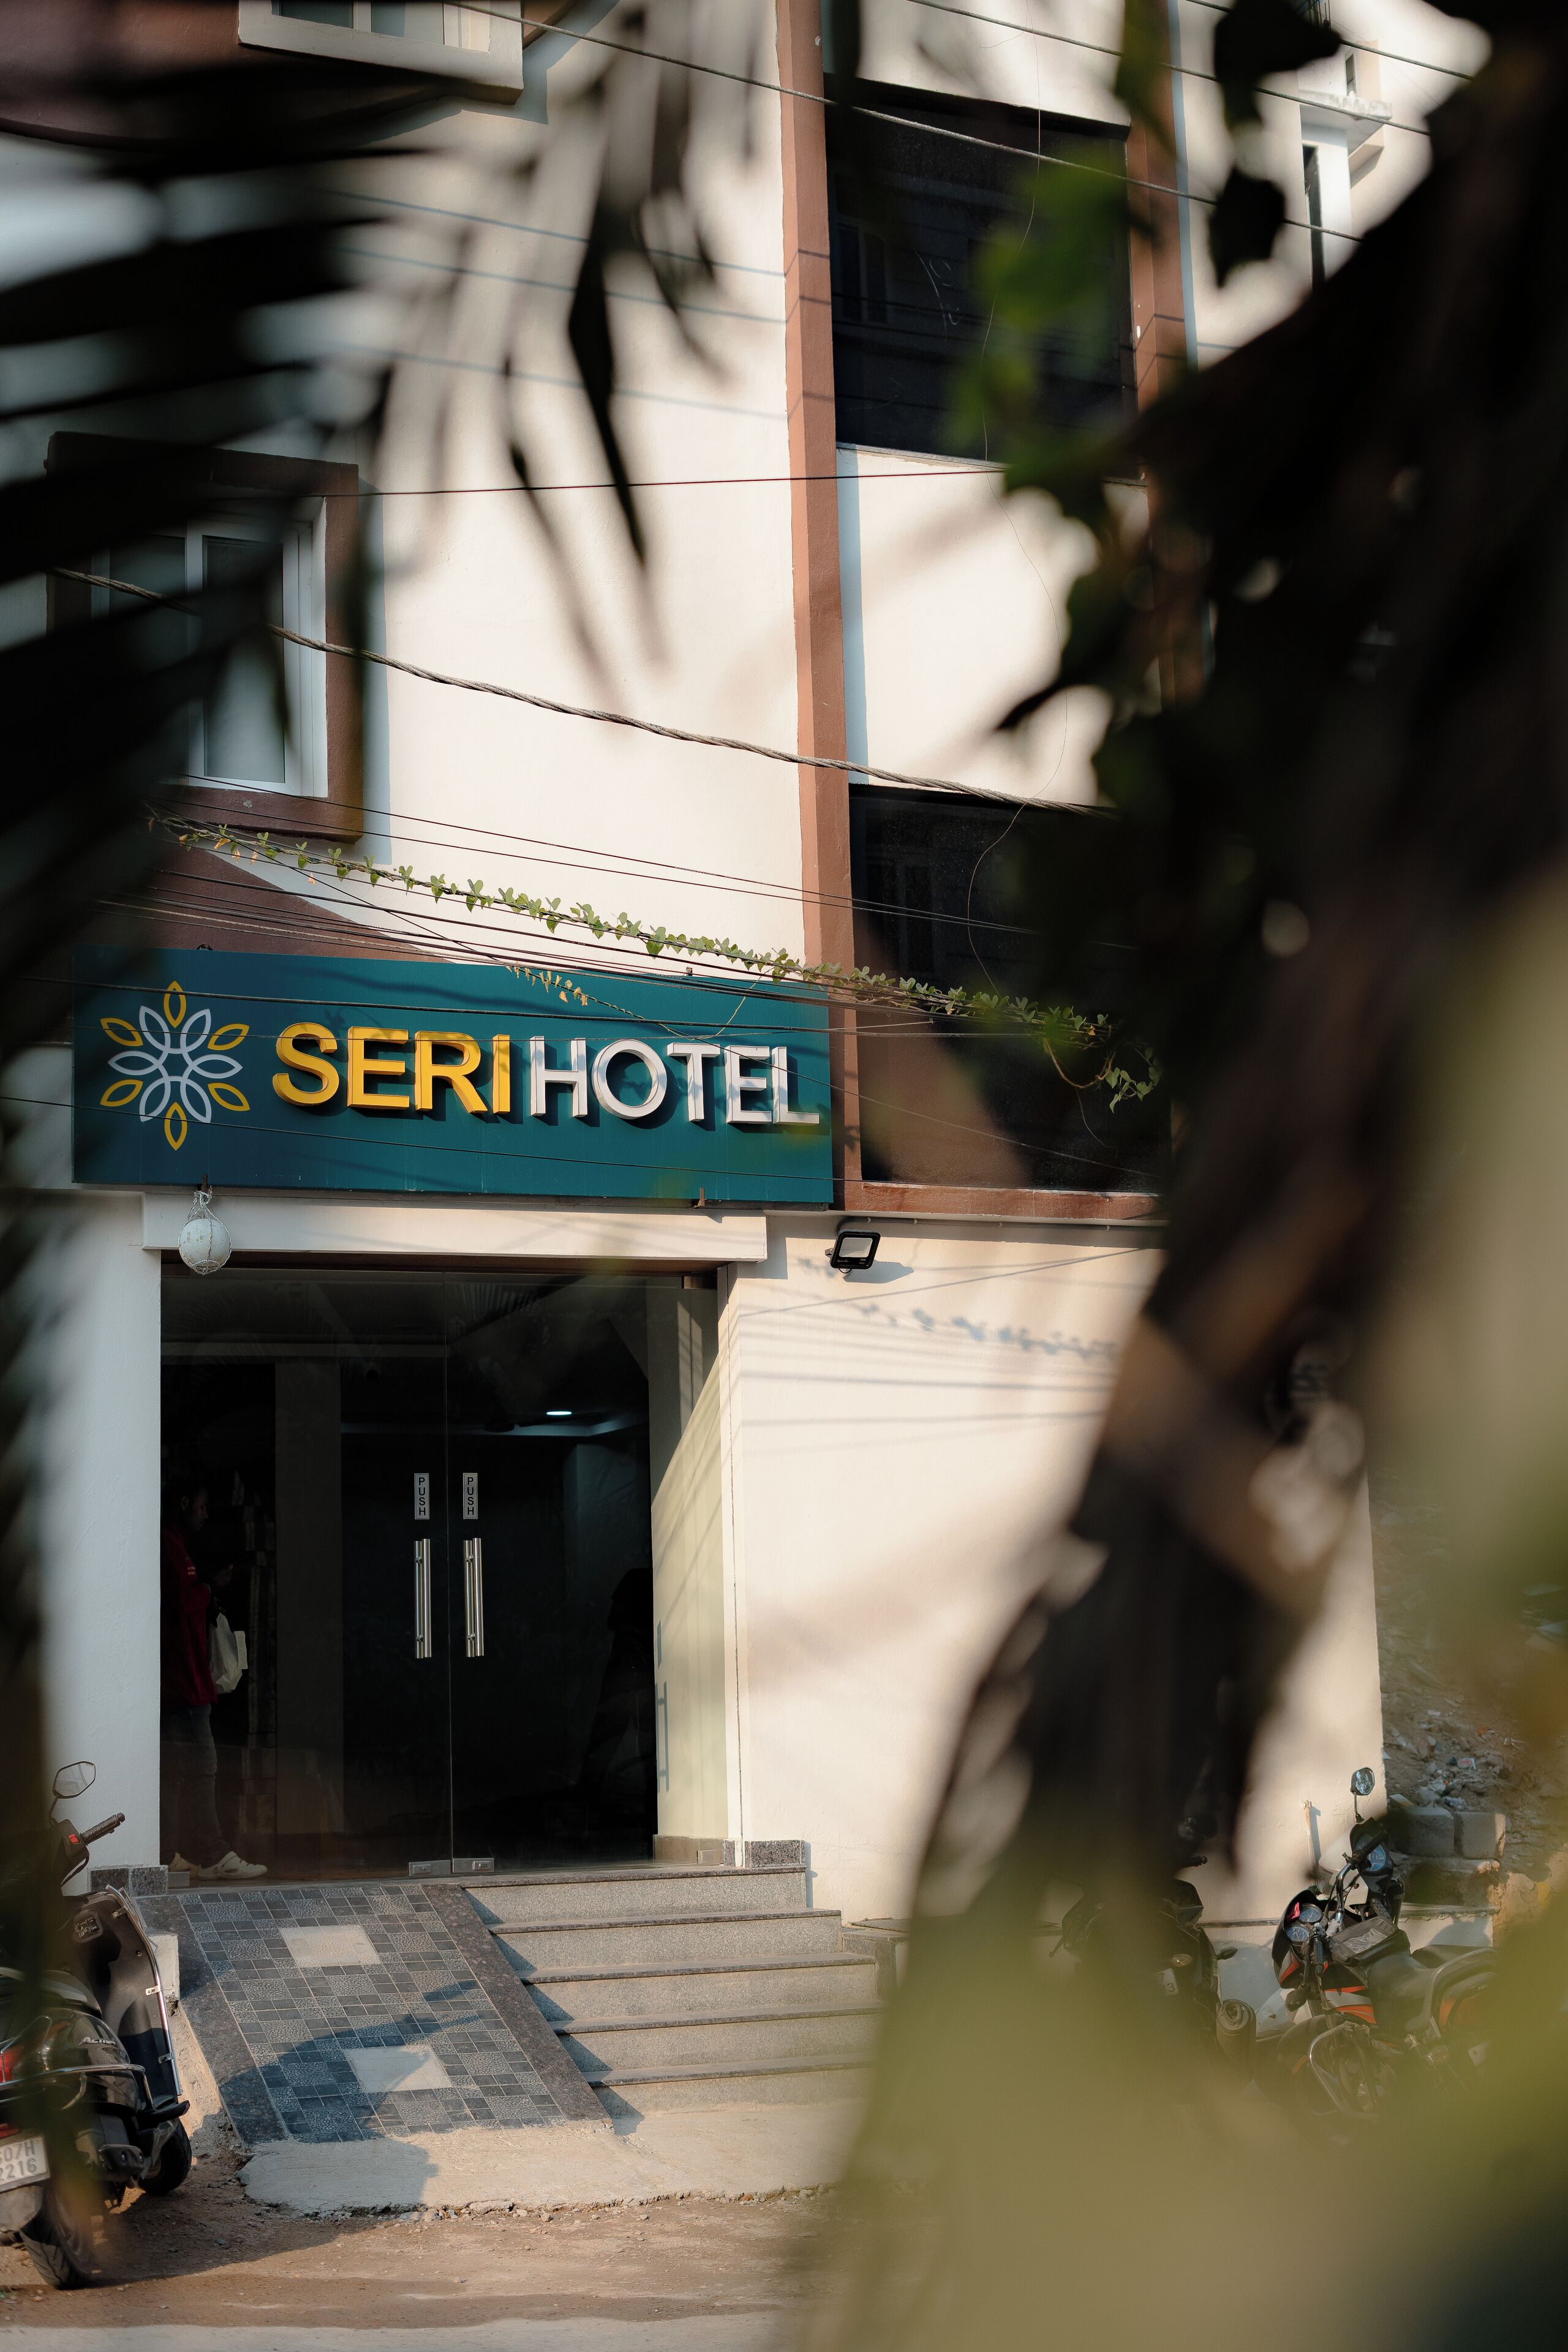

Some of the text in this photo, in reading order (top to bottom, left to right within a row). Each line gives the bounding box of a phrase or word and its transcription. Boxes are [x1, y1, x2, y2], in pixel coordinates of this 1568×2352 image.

[272, 1022, 820, 1125] SERI HOTEL
[0, 2140, 35, 2165] 07H
